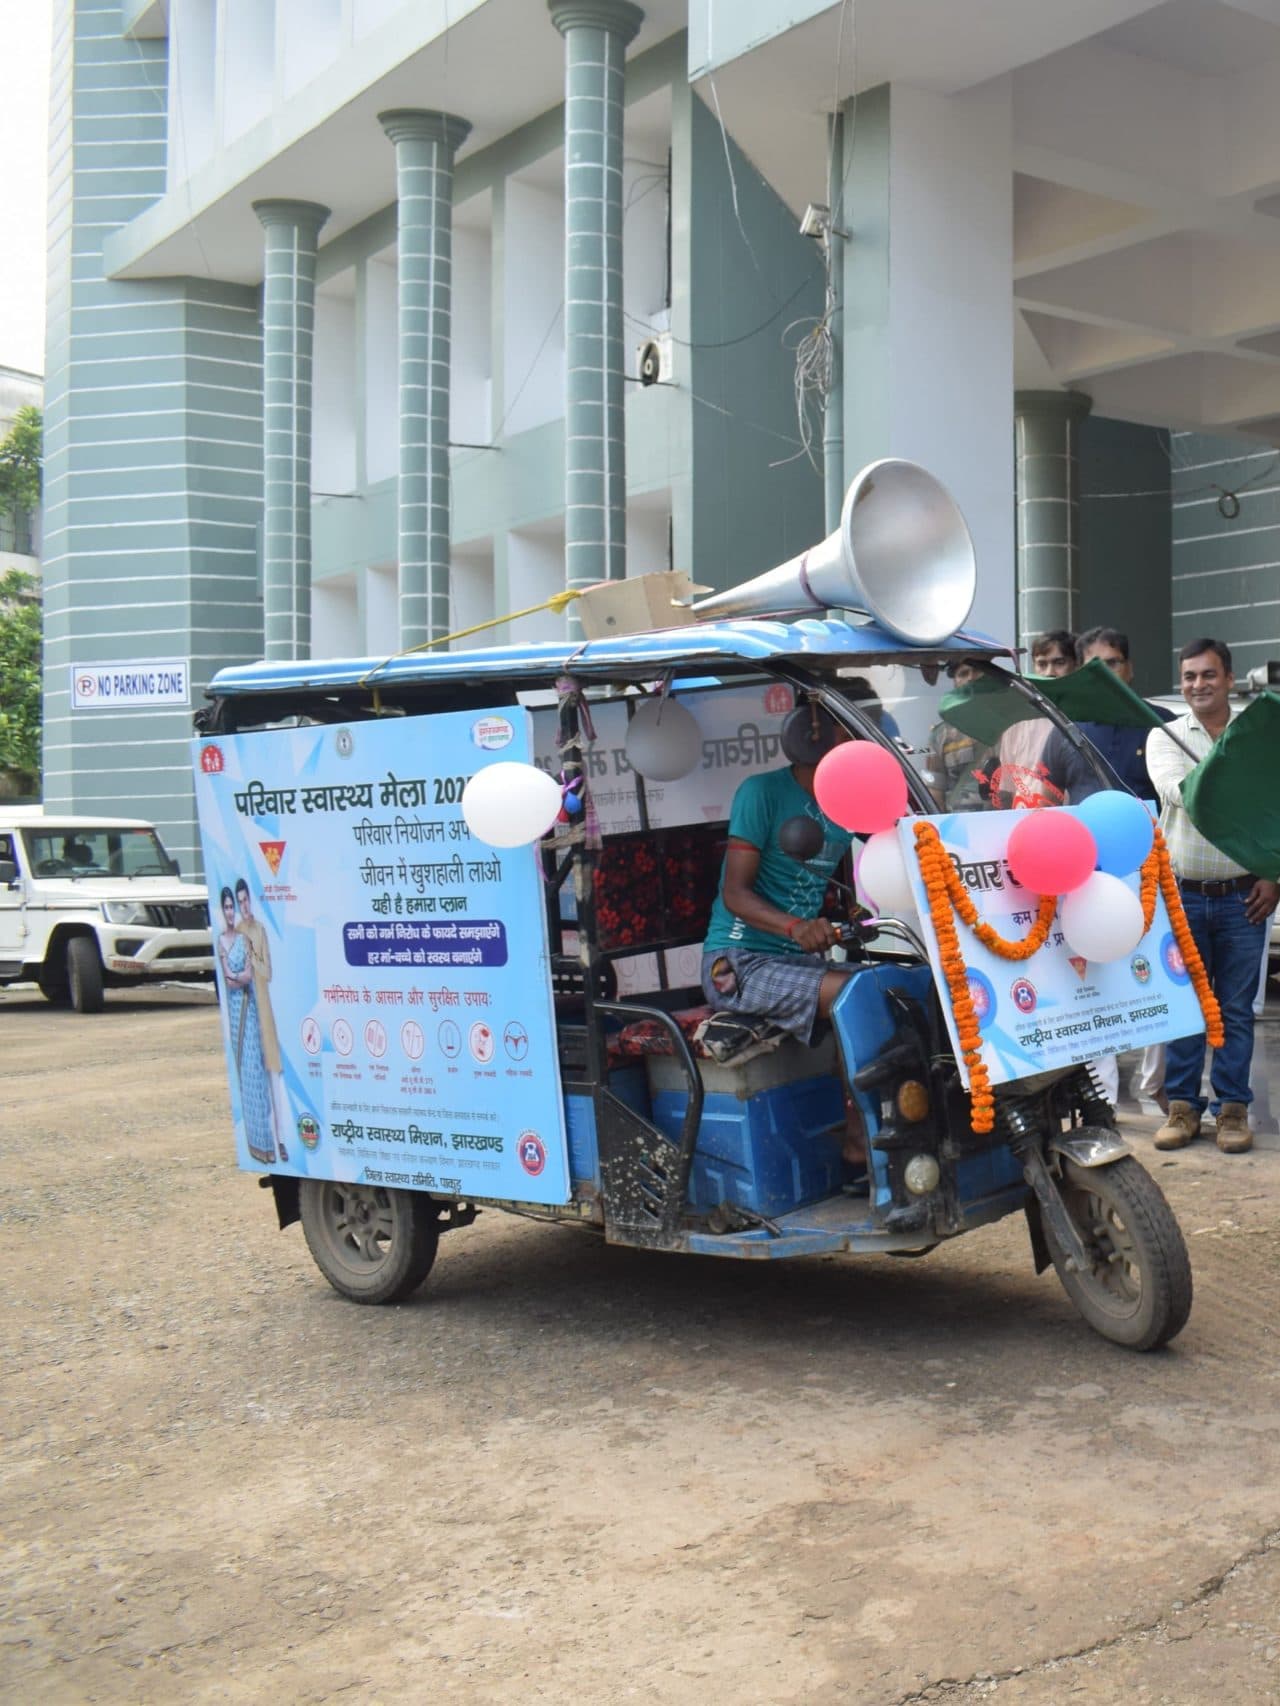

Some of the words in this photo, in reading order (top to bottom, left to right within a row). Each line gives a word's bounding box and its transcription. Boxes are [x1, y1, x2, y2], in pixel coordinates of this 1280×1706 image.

[98, 676, 110, 696] NO
[114, 674, 155, 695] PARKING
[157, 672, 183, 694] ZONE
[234, 780, 297, 816] परिवार
[300, 783, 373, 813] स्वास्थ्य
[378, 771, 427, 808] मेला
[433, 776, 472, 804] 202
[352, 817, 393, 846] परिवार
[394, 814, 445, 844] नियोजन
[360, 857, 394, 886] जीवन
[396, 857, 408, 885] में
[409, 853, 464, 893] खुशहाली
[466, 852, 502, 883] लाओ
[372, 893, 391, 914] यही
[395, 894, 403, 914] है
[406, 898, 436, 914] हमारा
[439, 896, 467, 913] प्लान
[347, 924, 365, 940] सभी
[366, 924, 378, 939] को
[396, 923, 420, 940] निरोध
[421, 923, 431, 939] के
[432, 923, 457, 939] फायदे
[1011, 911, 1032, 925] कम
[367, 951, 379, 964] हर
[413, 948, 426, 963] को
[362, 985, 372, 1003] के
[375, 991, 403, 1005] आसान
[408, 986, 424, 1005] और
[428, 986, 460, 1012] सुरक्षित
[1018, 1028, 1053, 1047] राष्ट्रीय
[1055, 1022, 1091, 1038] स्वास्थ्य
[1093, 1014, 1127, 1030] मिशन,
[1128, 1003, 1169, 1023] झारखण्ड
[331, 1119, 364, 1144] राष्ट्रीय
[366, 1126, 406, 1143] स्वास्थ्य
[408, 1124, 447, 1148] मिशन,
[451, 1133, 504, 1153] झारखण्ड
